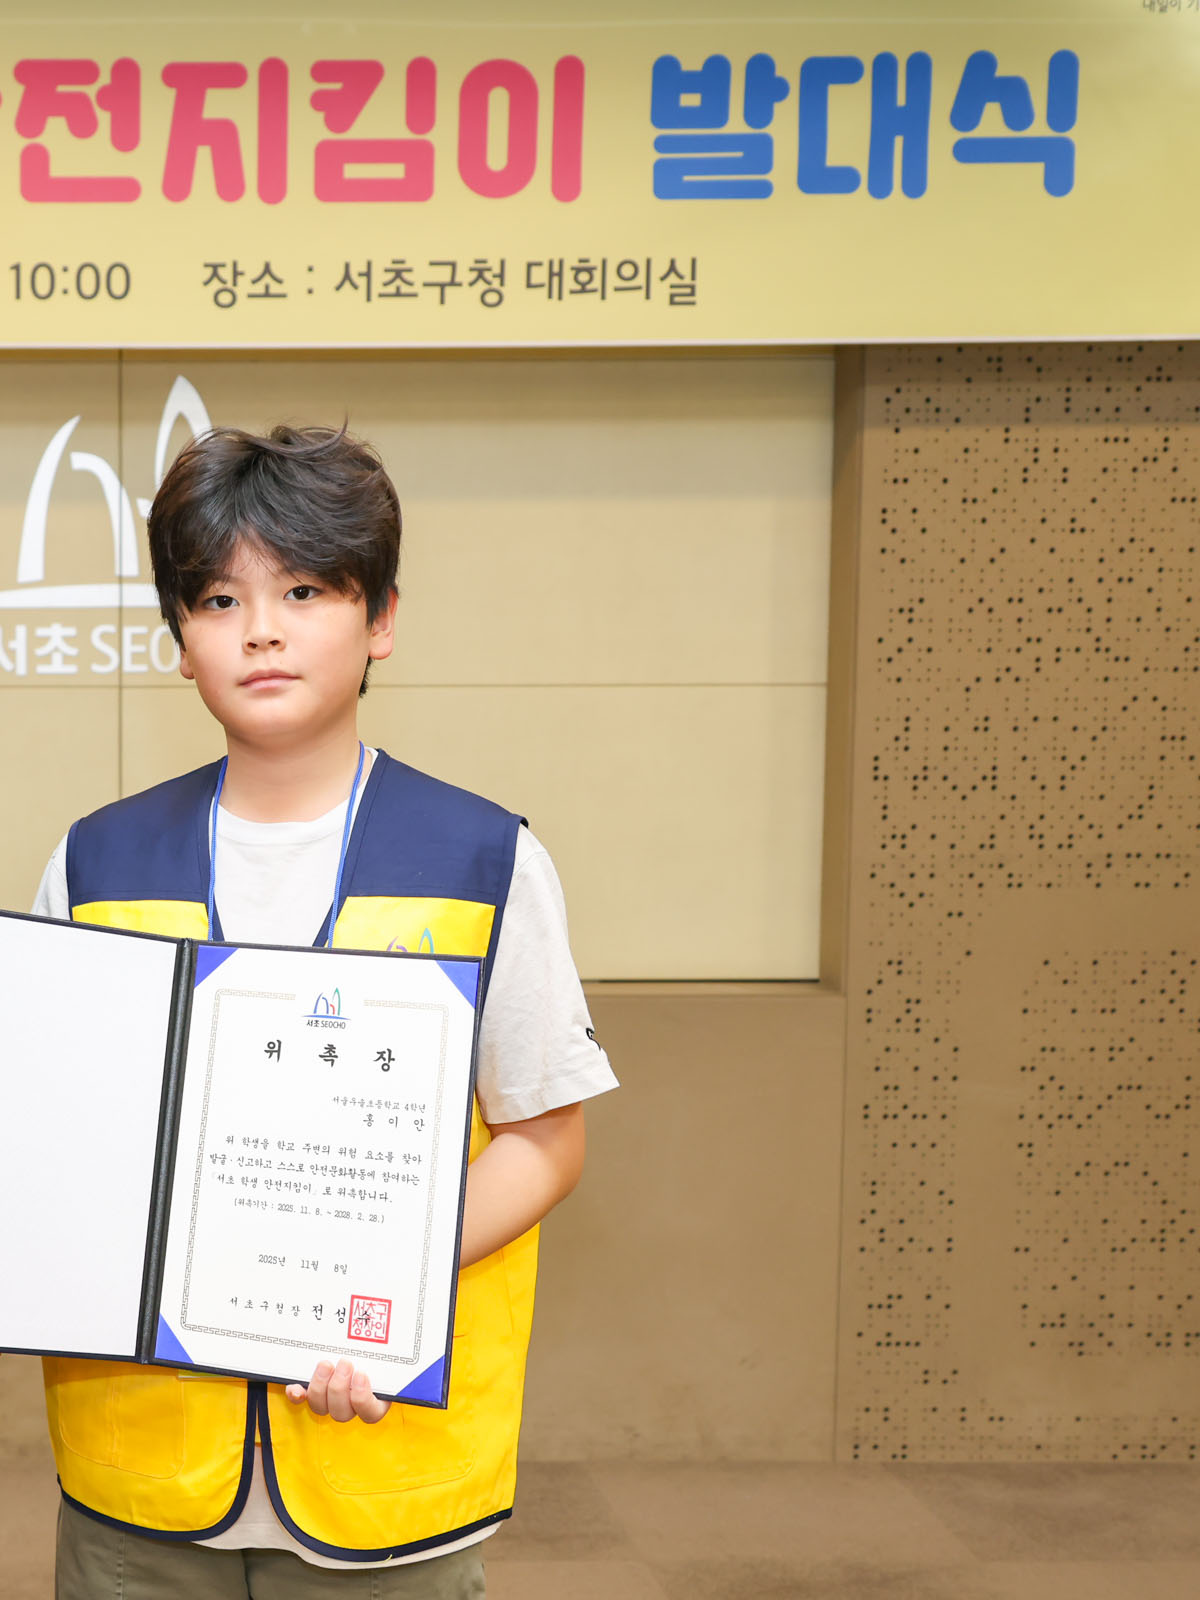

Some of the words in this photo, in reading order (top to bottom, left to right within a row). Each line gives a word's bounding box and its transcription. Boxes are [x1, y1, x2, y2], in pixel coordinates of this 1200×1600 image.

[650, 49, 1080, 199] 발대식
[9, 262, 131, 300] 10:00
[202, 260, 288, 308] 장소
[334, 258, 506, 307] 서초구청
[525, 257, 698, 306] 대회의실
[90, 624, 182, 673] SEO
[306, 1019, 320, 1028] 서초
[320, 1020, 346, 1030] SEOCHO
[404, 1102, 426, 1114] 4학년
[226, 1135, 234, 1145] 위
[242, 1136, 269, 1150] 학생을
[277, 1139, 295, 1152] 학교
[302, 1142, 331, 1156] 주변의
[338, 1146, 357, 1159] 위험
[365, 1150, 394, 1164] 요소를
[402, 1153, 422, 1166] 찾아
[277, 1161, 305, 1173] 스스로
[309, 1163, 376, 1181] 안전문화활동에
[382, 1171, 420, 1187] 참여하는
[240, 1176, 258, 1189] 학생
[322, 1186, 332, 1196] 로
[337, 1187, 392, 1203] 위촉합니다.
[277, 1203, 296, 1213] 2025.
[300, 1205, 311, 1215] 11.
[315, 1207, 323, 1216] 8.
[368, 1213, 385, 1224] 28.)
[258, 1254, 286, 1267] 2025년
[300, 1259, 319, 1271] 11월
[333, 1263, 348, 1275] 8일
